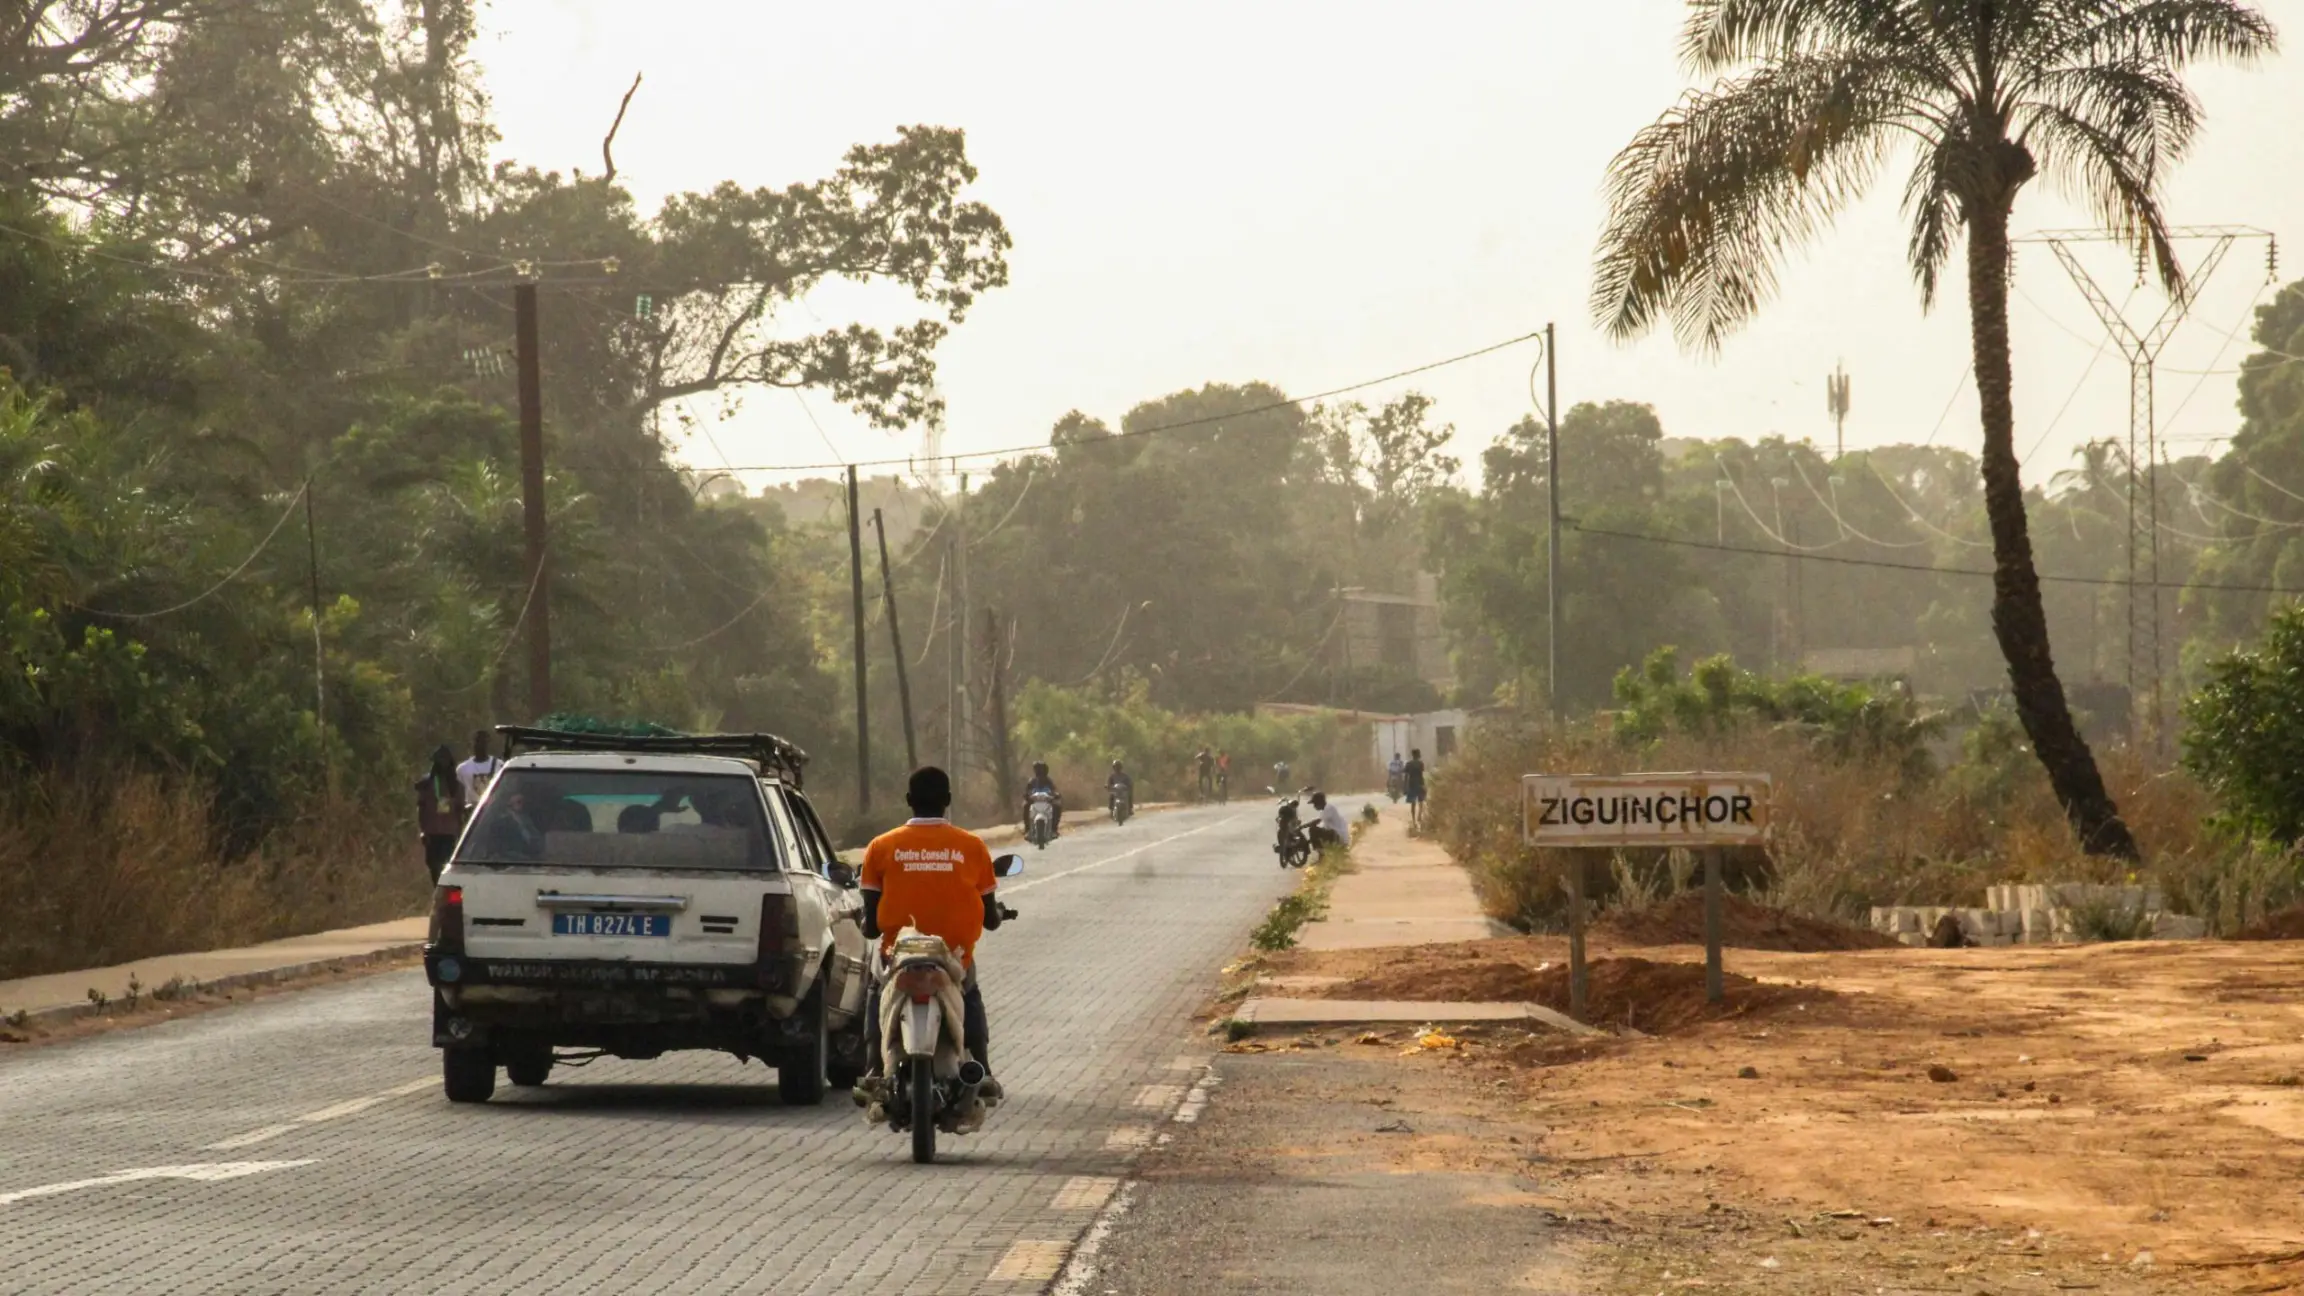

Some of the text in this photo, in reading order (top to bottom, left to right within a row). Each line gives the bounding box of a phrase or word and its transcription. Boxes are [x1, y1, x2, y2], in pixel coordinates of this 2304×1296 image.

[1538, 795, 1753, 825] ZIGUINCHOR
[894, 848, 919, 861] Centre
[920, 848, 950, 861] Conseil
[566, 915, 653, 935] TH 8274 E
